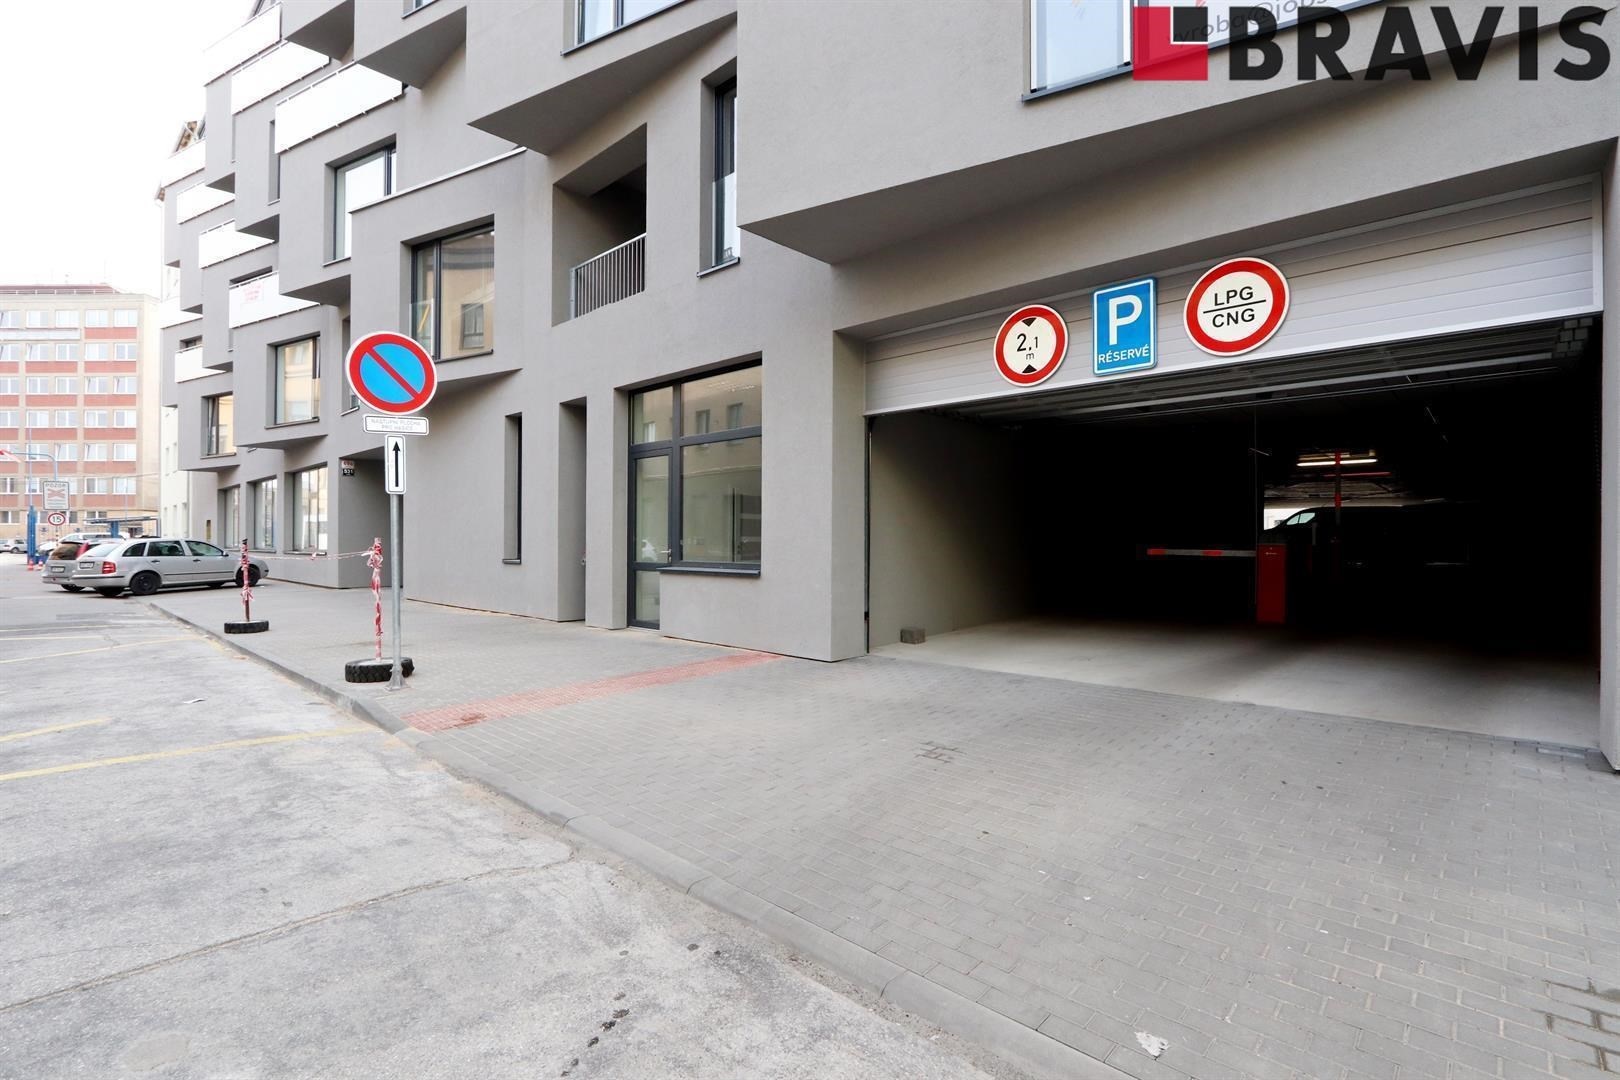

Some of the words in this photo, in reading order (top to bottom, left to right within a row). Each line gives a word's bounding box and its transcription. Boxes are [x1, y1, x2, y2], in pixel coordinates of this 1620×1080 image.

[1168, 0, 1327, 48] vyroba@jo
[1213, 286, 1254, 306] LPG
[1108, 294, 1143, 346] P
[1211, 308, 1255, 328] CNG
[1025, 352, 1035, 360] m
[1098, 345, 1150, 364] RÉSERVÉ
